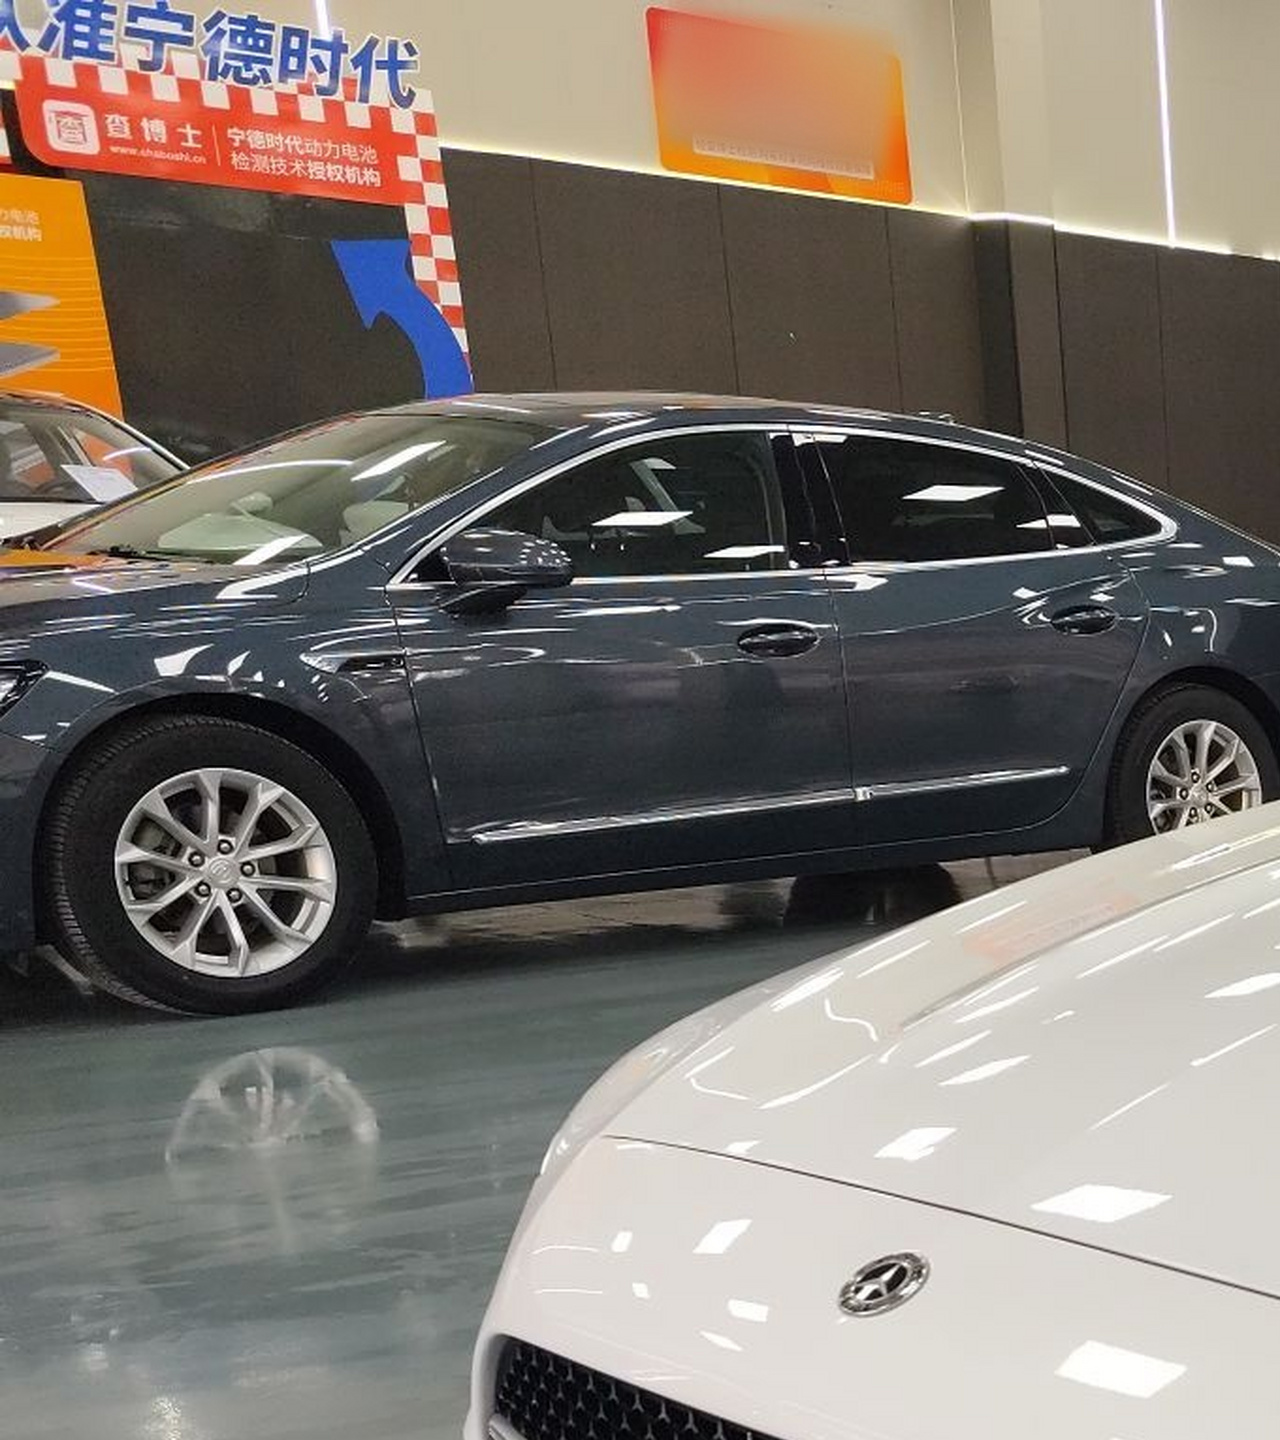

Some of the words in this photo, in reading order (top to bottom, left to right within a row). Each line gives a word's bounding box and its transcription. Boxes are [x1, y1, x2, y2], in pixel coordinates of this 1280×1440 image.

[105, 114, 203, 148] 查博士
[227, 127, 379, 164] 宁德时代动力电池
[231, 151, 382, 187] 检测技术授权机构
